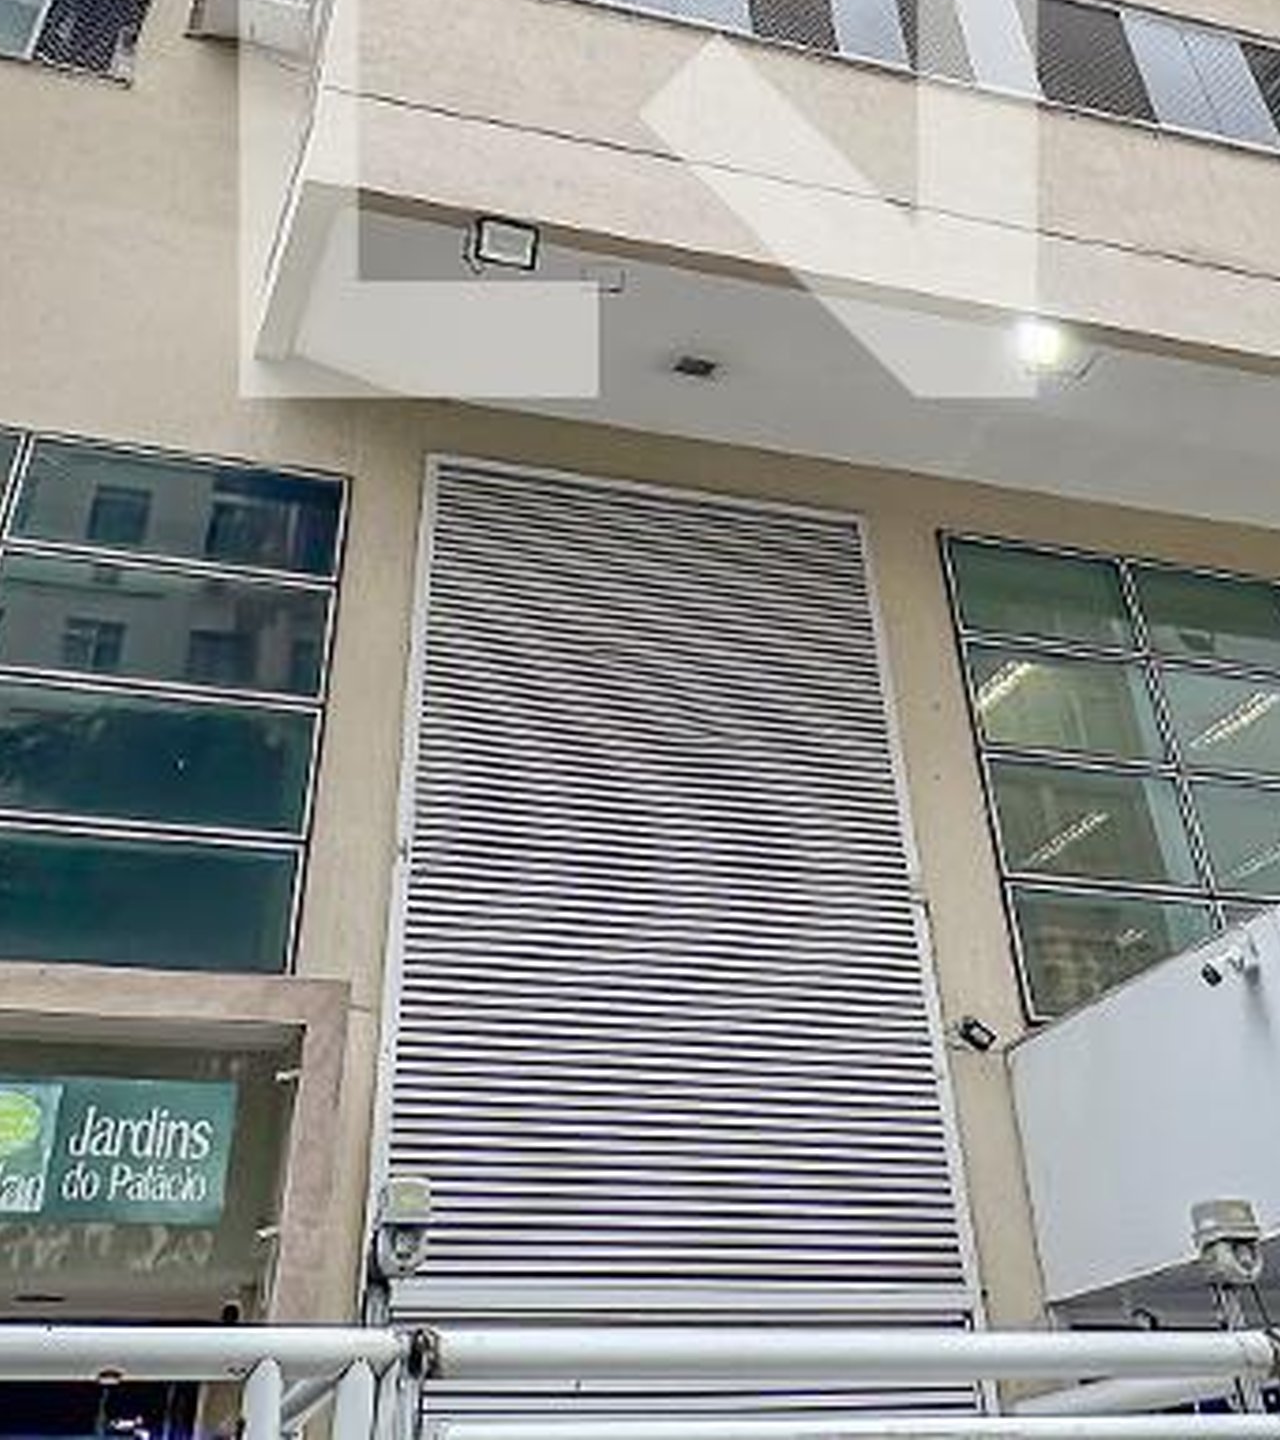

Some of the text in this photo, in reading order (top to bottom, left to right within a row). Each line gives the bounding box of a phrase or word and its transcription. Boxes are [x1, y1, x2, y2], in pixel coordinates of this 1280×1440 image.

[69, 1105, 214, 1160] Jardins
[61, 1160, 207, 1202] do Palácio
